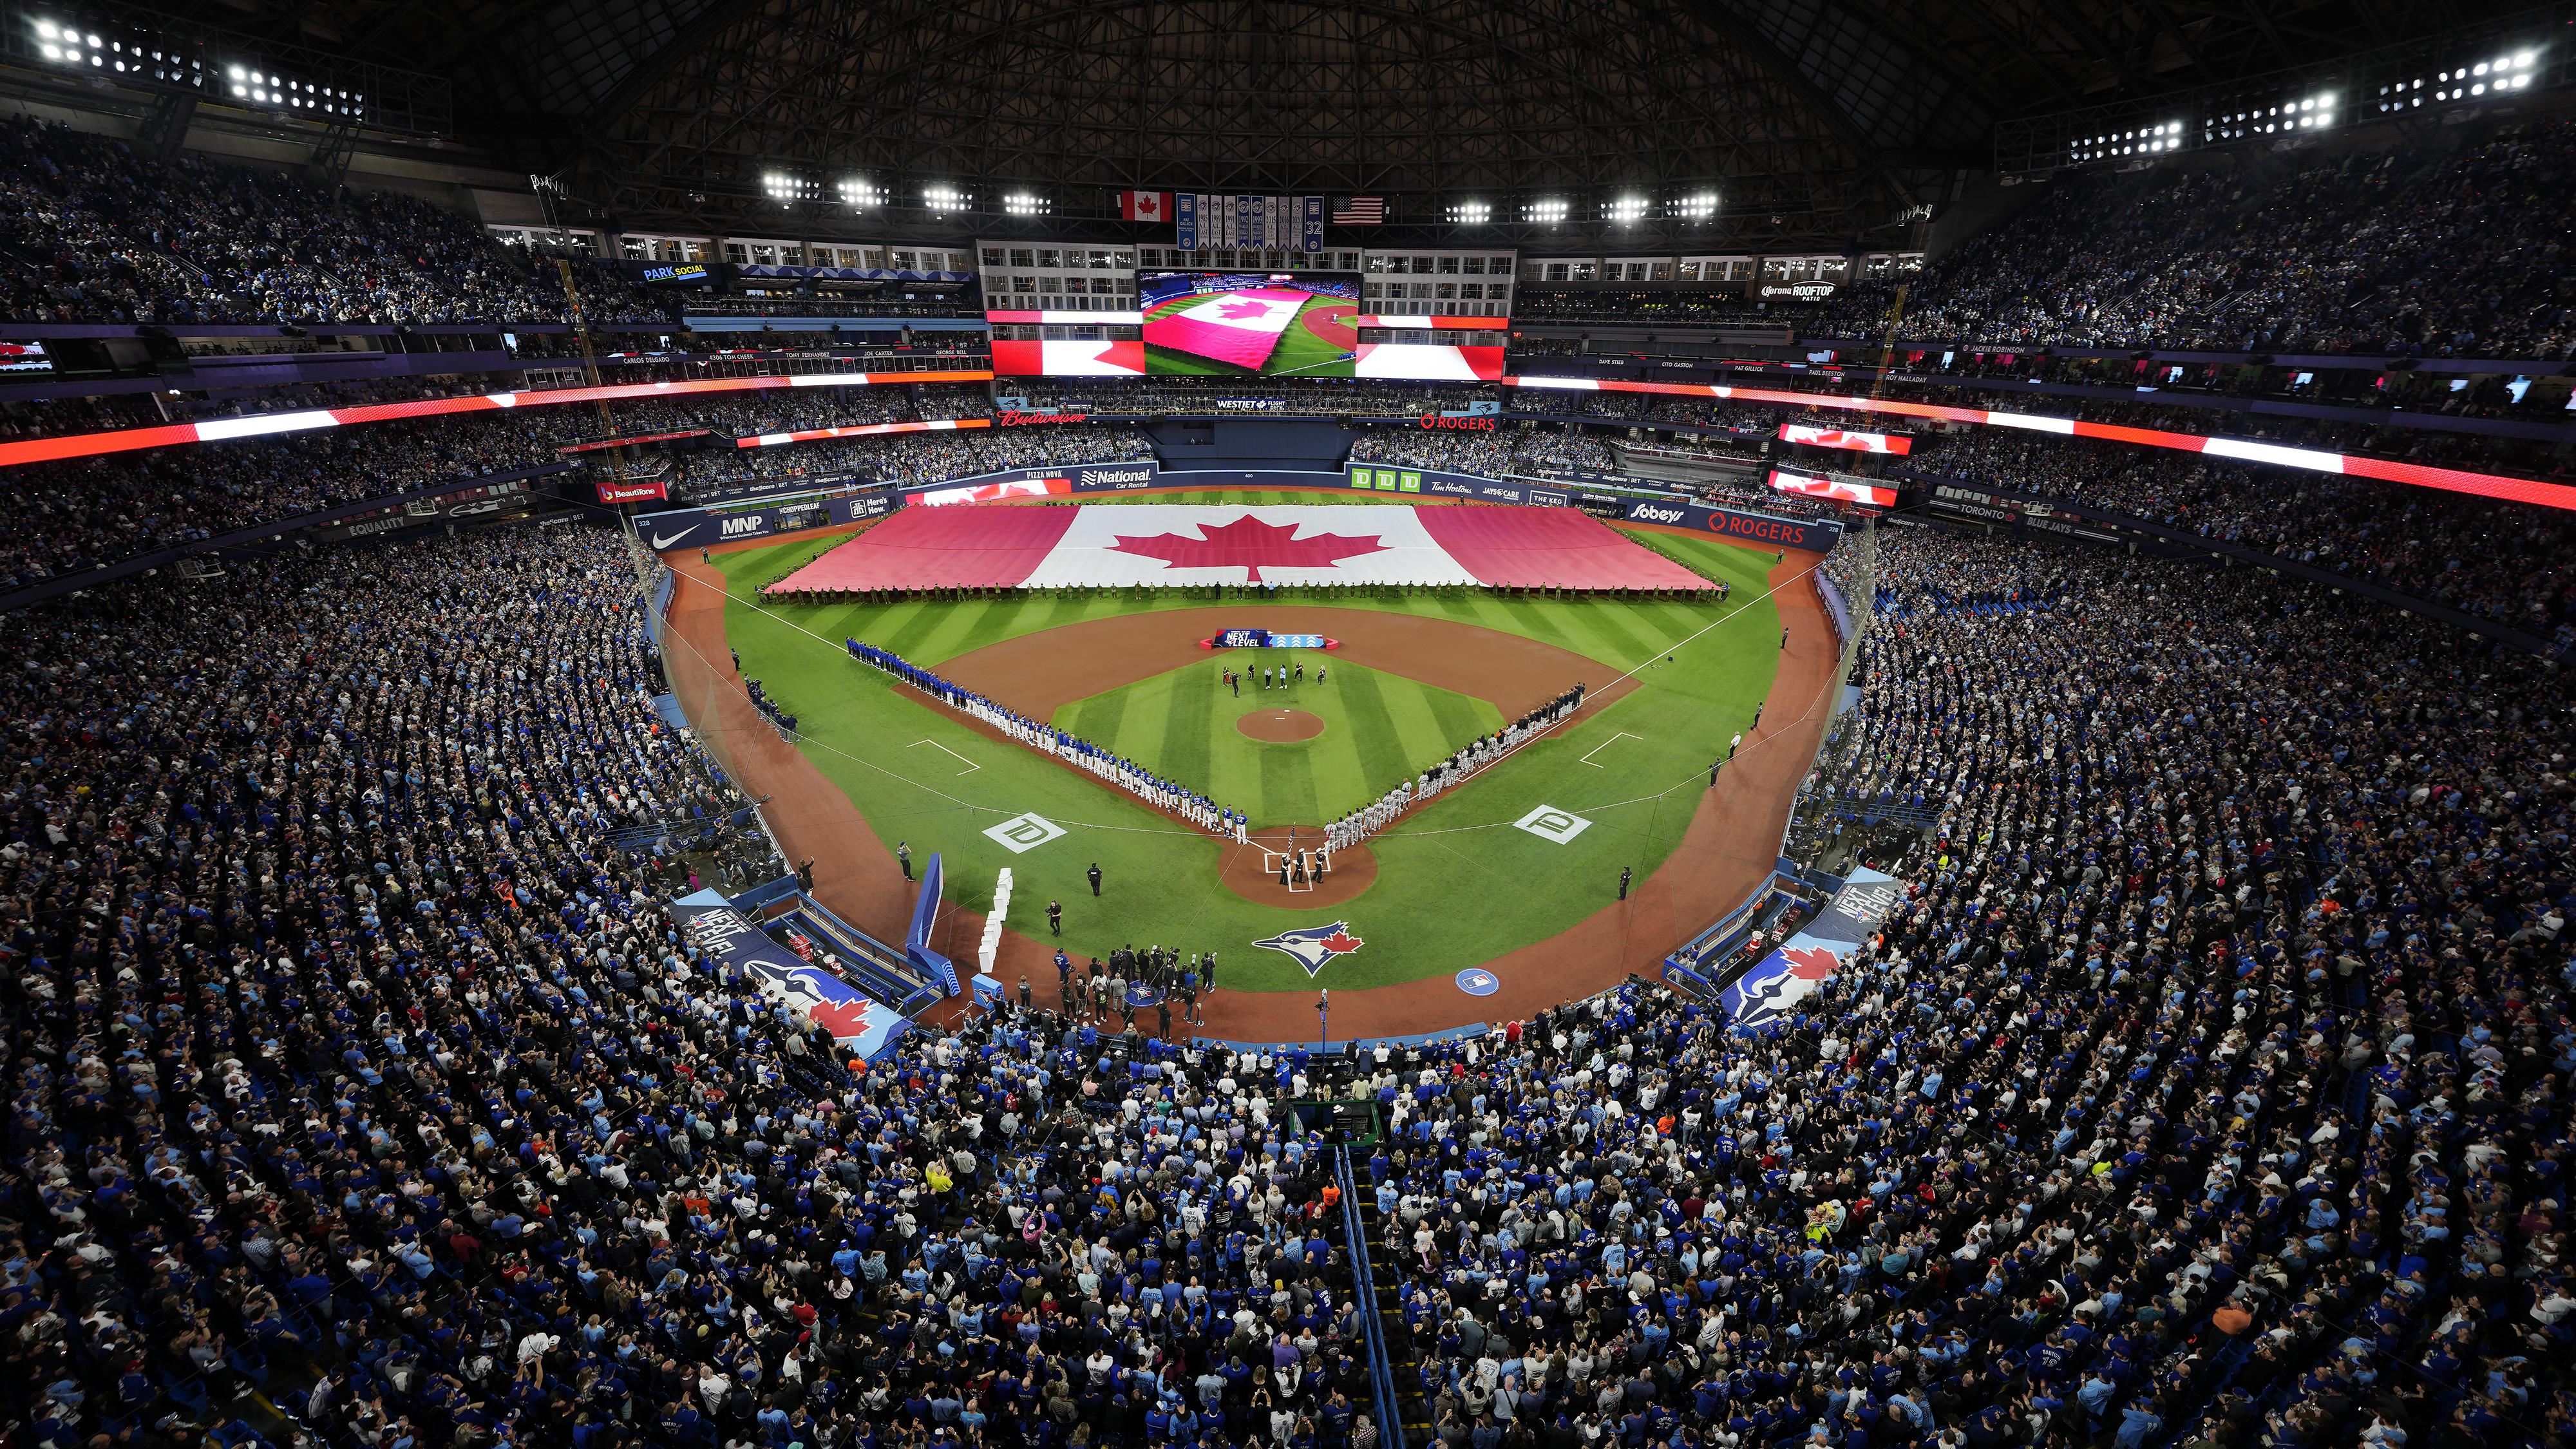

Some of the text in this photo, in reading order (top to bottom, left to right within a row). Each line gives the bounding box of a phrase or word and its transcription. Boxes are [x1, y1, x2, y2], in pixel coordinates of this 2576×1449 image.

[1198, 214, 1208, 223] 1985
[1211, 214, 1221, 223] 1989
[1226, 215, 1235, 223] 1991
[1306, 221, 1321, 234] 32
[644, 264, 706, 280] PARK SOCIAL
[1761, 285, 1835, 298] Corona ROOFTOP
[1992, 346, 2025, 354] ROBINSON
[1899, 375, 1927, 384] HALLADAY
[1217, 400, 1256, 410] WESTJET
[996, 410, 1087, 426] Budweiser
[1438, 417, 1495, 431] ROGERS
[1354, 471, 1418, 488] TD TD TD
[1602, 475, 1627, 483] theScore
[615, 488, 656, 498] BeautiTone
[1432, 482, 1472, 494] Tim Hortons
[866, 496, 887, 506] Here's
[1549, 497, 1563, 505] KEG
[868, 506, 886, 515] How.
[1630, 503, 1685, 524] Sobeys
[540, 516, 569, 527] theScore
[1888, 516, 1915, 527] theScore
[1959, 504, 2072, 534] TORONTO BLUE JAYS
[348, 516, 405, 536] EQUALITY
[722, 515, 762, 535] MNP
[1729, 516, 1806, 544] ROGERS
[1723, 1145, 1732, 1153] 13
[1672, 1204, 1680, 1215] 19
[1616, 1255, 1622, 1263] 4
[1323, 1297, 1331, 1307] 5
[2042, 1349, 2061, 1360] BAUTISTA
[2042, 1356, 2058, 1367] 19
[1483, 1365, 1496, 1376] 27
[1895, 1400, 1918, 1417] FERNANDEZ
